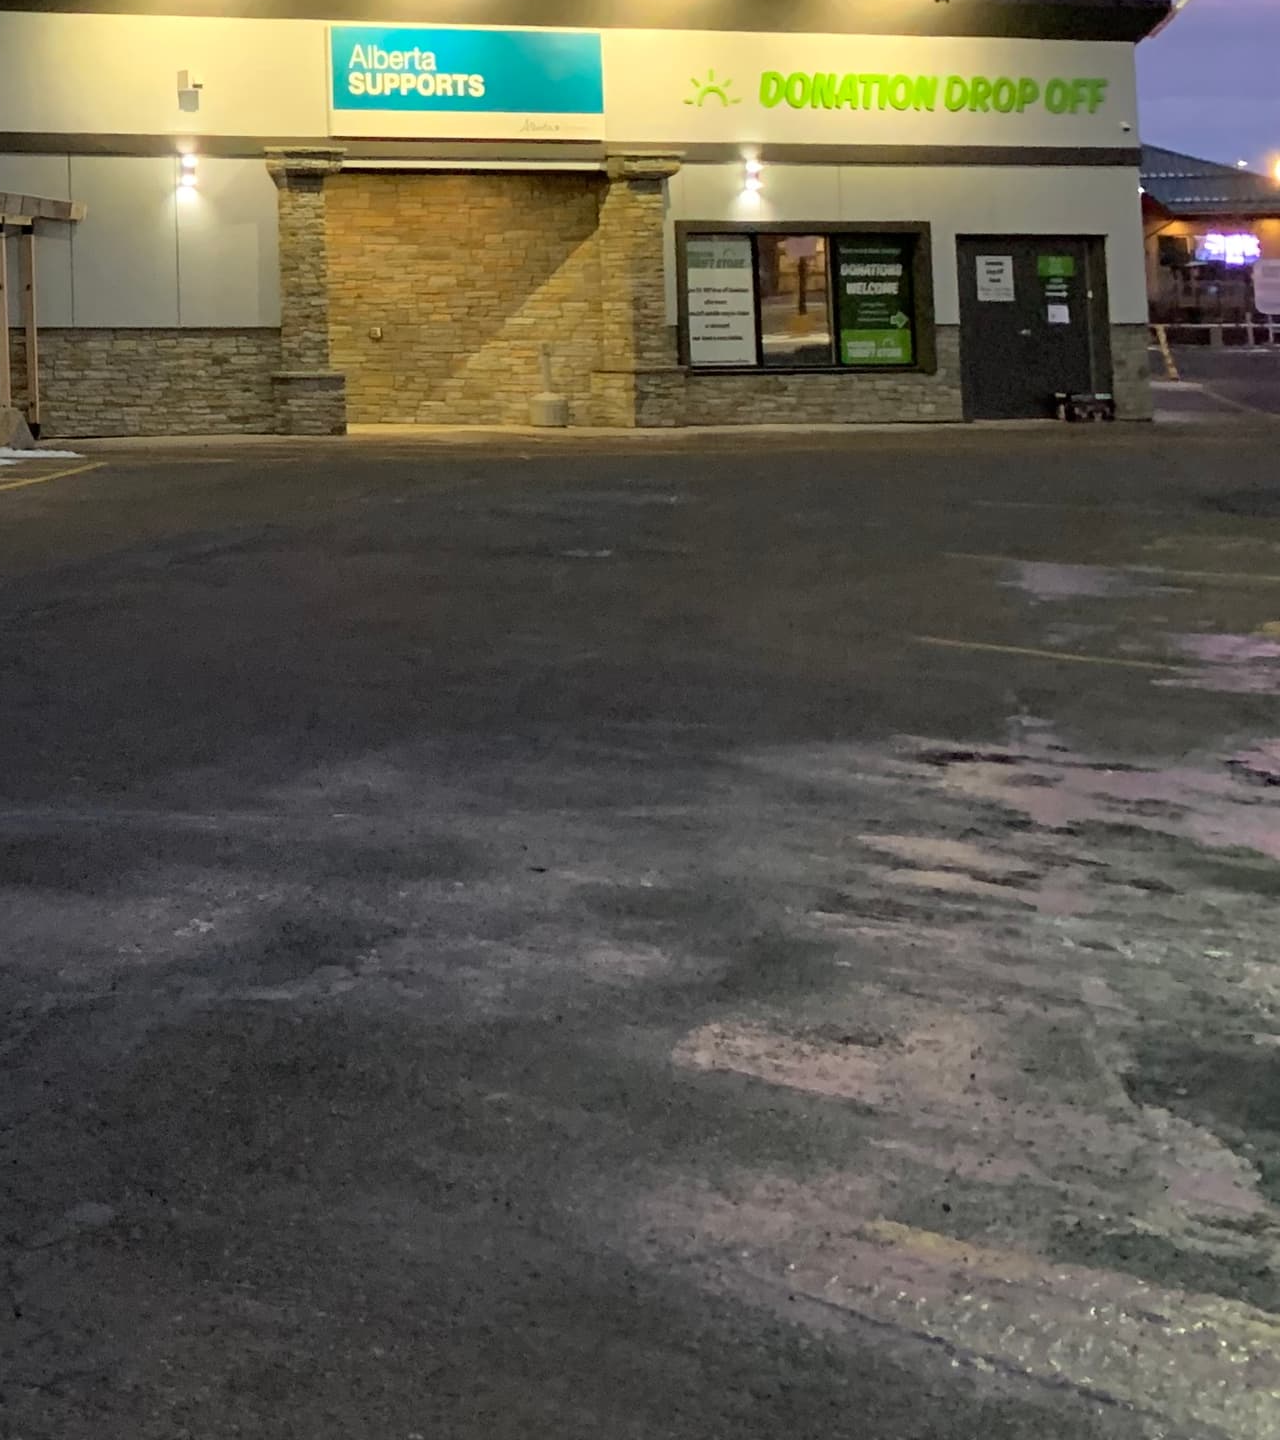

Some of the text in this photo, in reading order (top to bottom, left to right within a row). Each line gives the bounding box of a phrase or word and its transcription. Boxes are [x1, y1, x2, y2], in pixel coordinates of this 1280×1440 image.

[348, 43, 437, 71] Alberta
[348, 71, 486, 97] SUPPORTS
[759, 71, 1109, 115] DONATION DROP OFF
